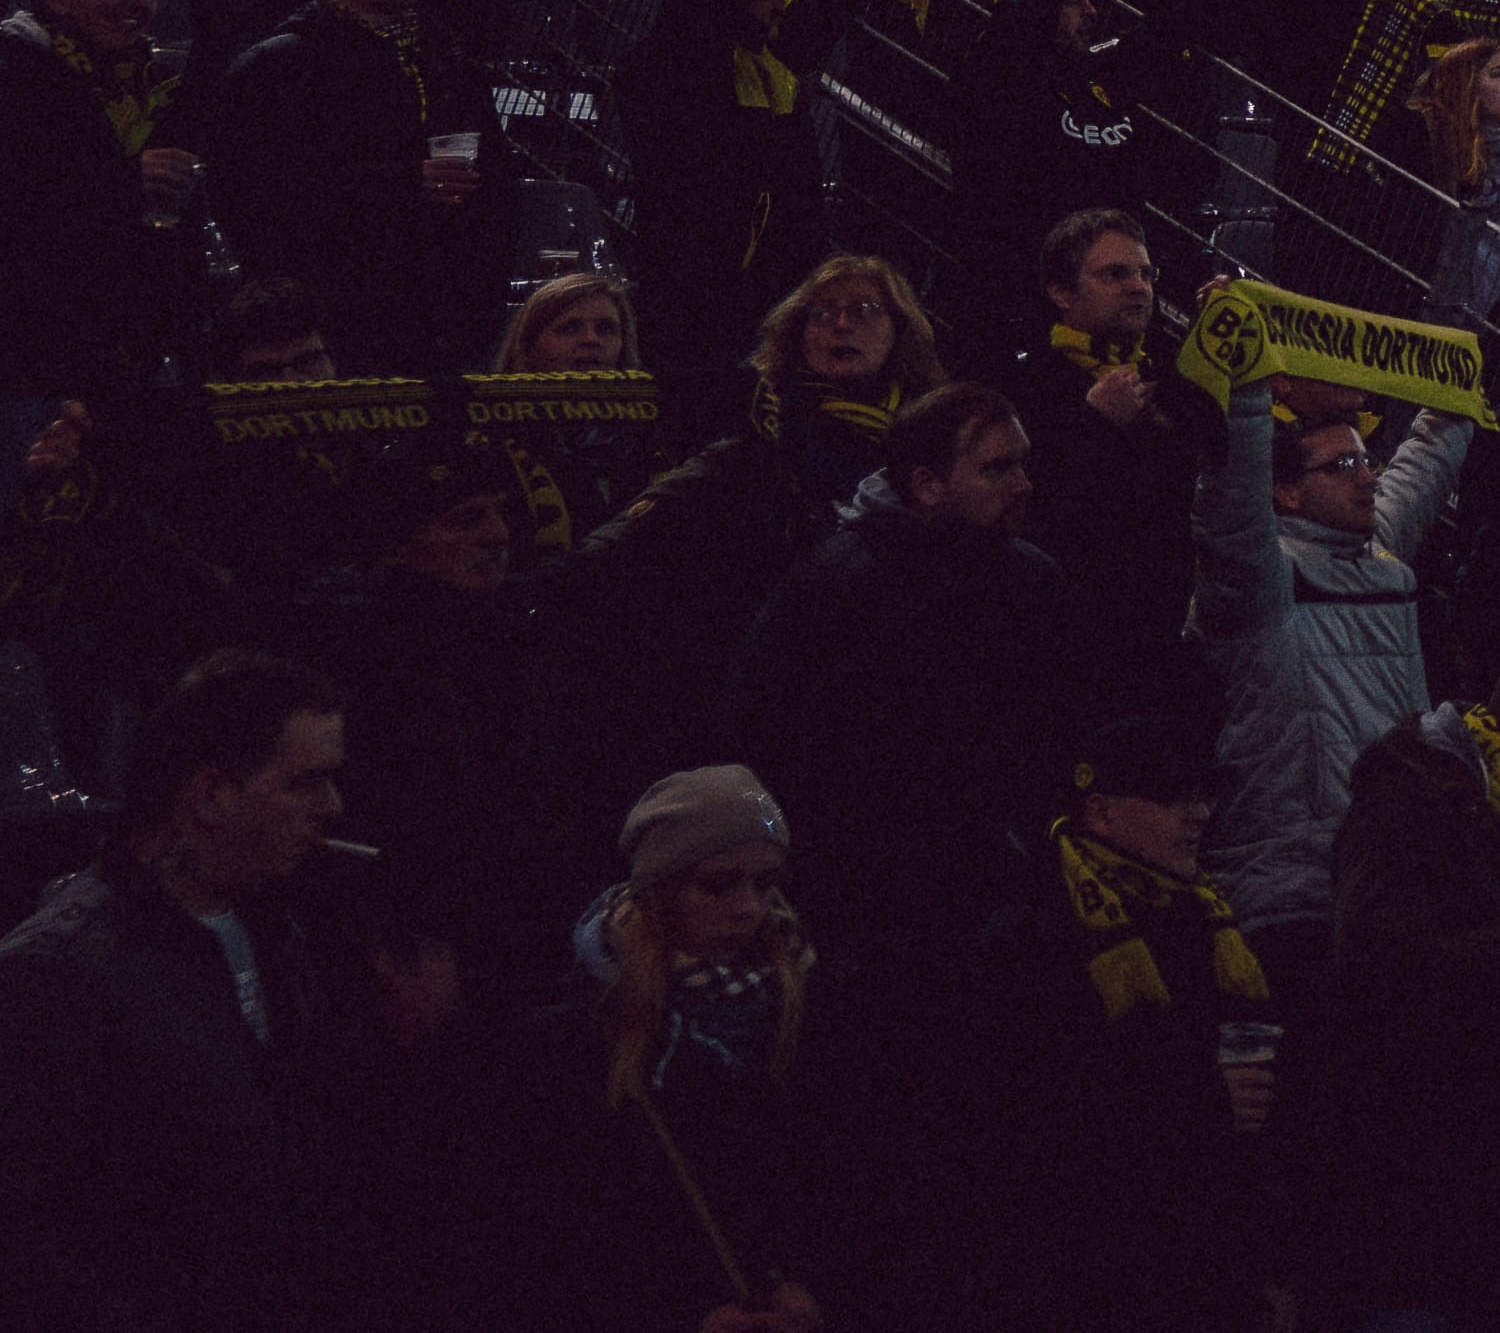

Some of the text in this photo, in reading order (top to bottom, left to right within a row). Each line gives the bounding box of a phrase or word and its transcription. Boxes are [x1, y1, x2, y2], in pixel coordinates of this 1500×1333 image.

[1361, 321, 1478, 391] DORTMUND
[212, 404, 430, 444] DORTMUND
[466, 400, 660, 424] DORTMUND
